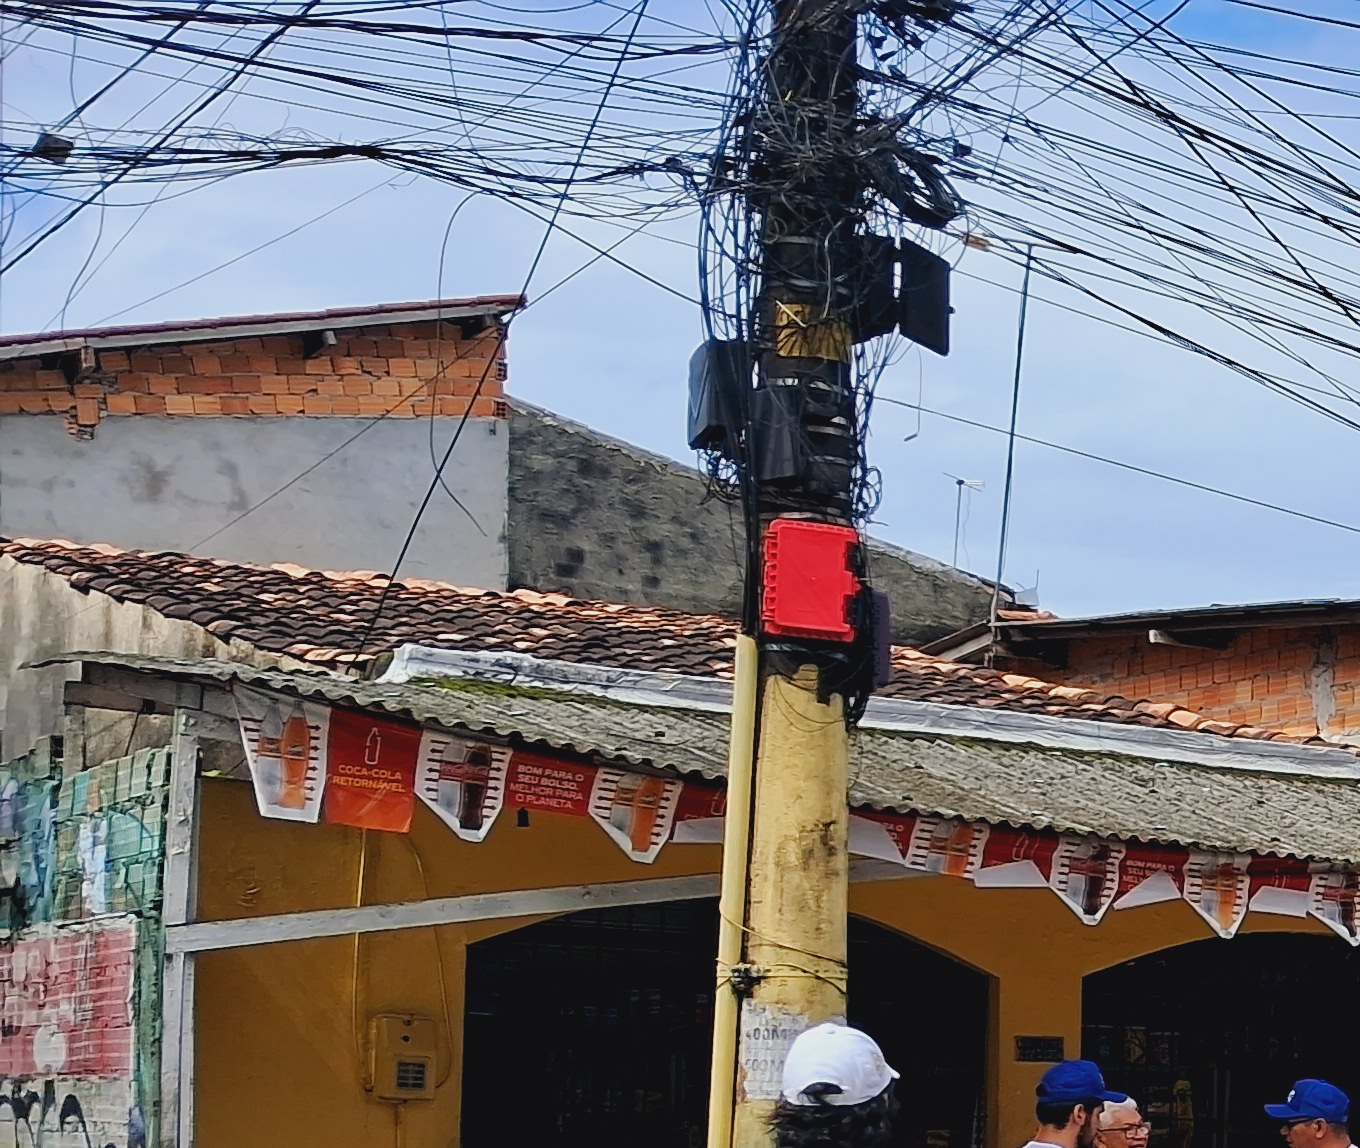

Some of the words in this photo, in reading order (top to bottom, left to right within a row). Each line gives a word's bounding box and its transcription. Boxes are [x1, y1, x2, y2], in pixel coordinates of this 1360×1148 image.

[338, 764, 402, 780] COCA-COLA
[517, 774, 539, 784] SEU
[518, 764, 543, 776] BOM
[544, 768, 573, 780] PARA
[576, 774, 585, 782] O
[332, 775, 406, 793] RETORNÁVEL
[509, 782, 554, 797] MELHOR
[554, 788, 584, 801] PARA
[515, 794, 523, 802] O
